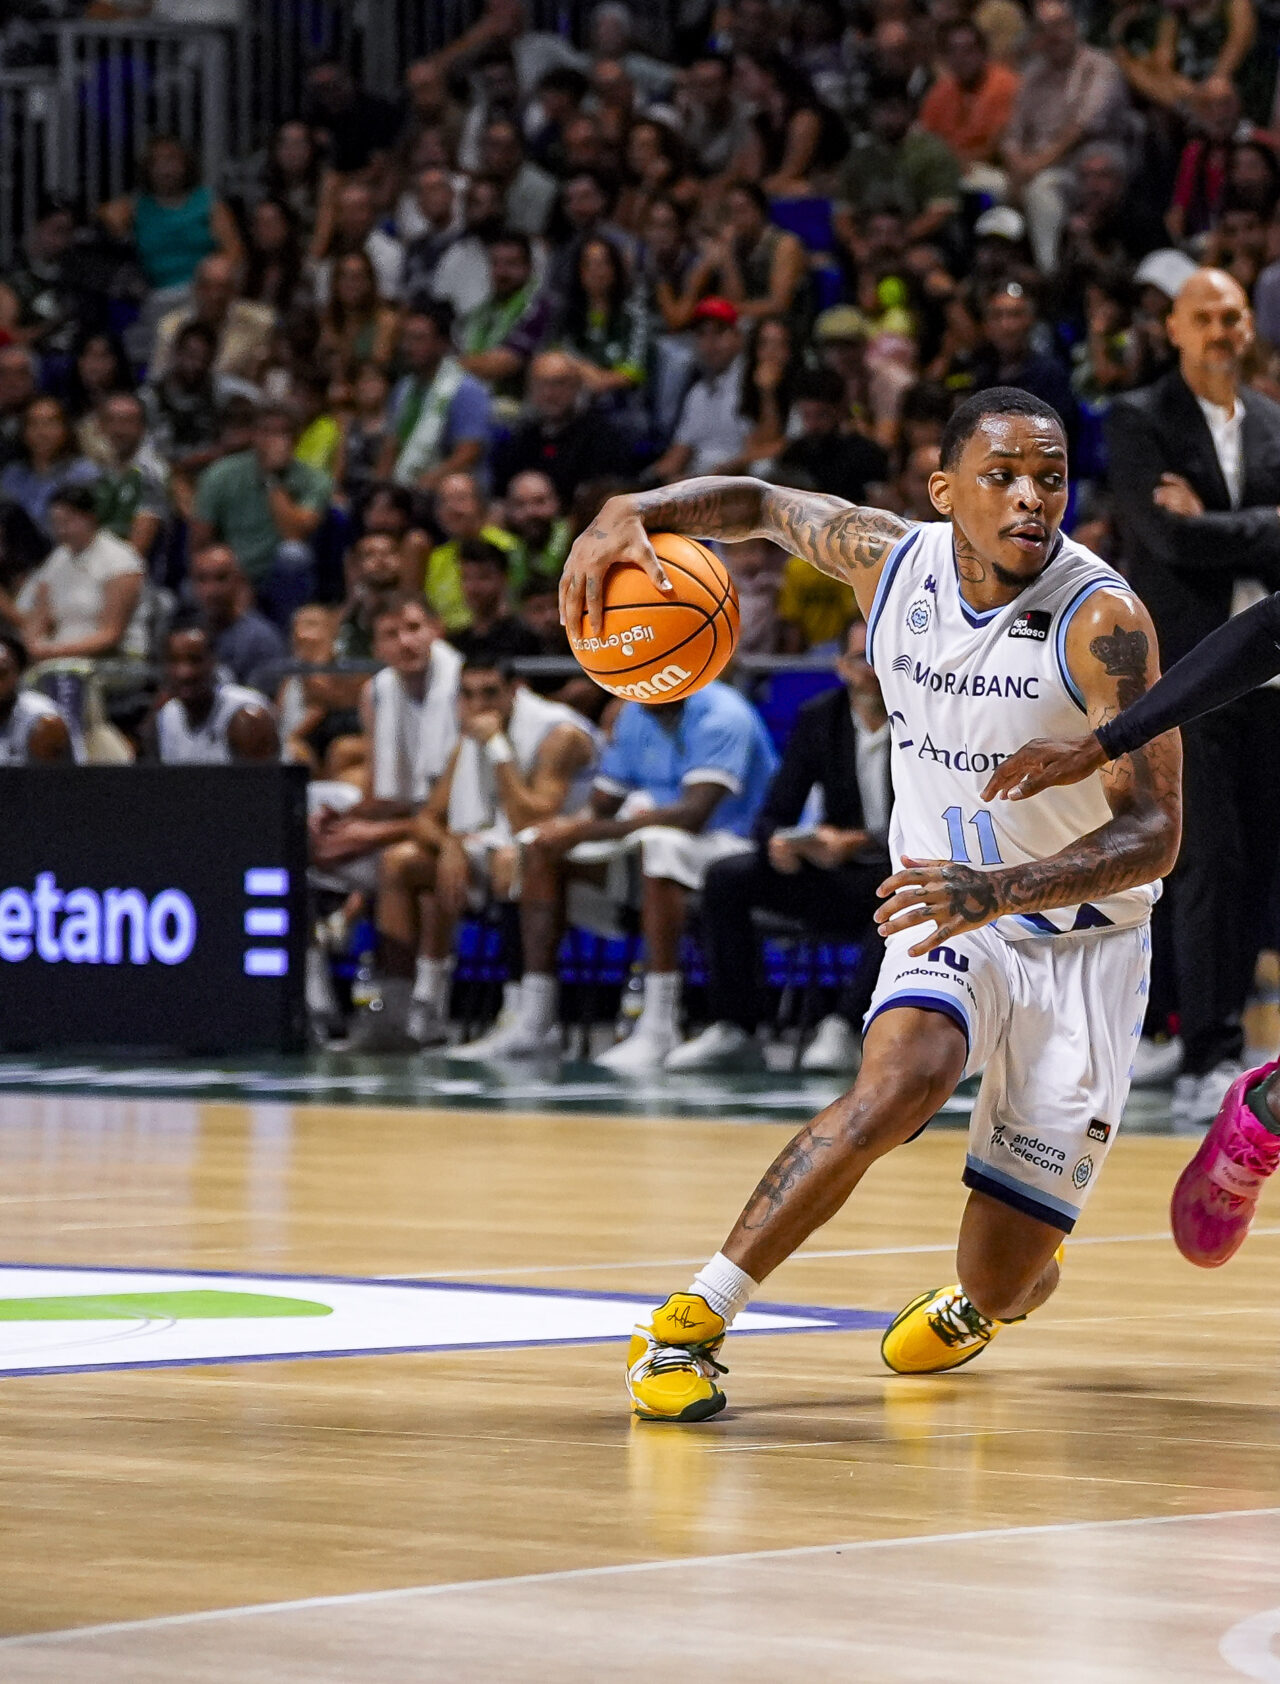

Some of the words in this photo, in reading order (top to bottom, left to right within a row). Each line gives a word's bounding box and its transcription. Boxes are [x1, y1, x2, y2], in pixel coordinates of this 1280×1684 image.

[620, 625, 655, 642] liga
[1010, 627, 1046, 639] endesa
[941, 806, 1004, 865] 11
[0, 869, 198, 966] etano
[894, 967, 950, 985] Andorra
[953, 974, 965, 986] la
[1088, 1126, 1106, 1141] acb
[1008, 1141, 1064, 1176] telecom
[1012, 1134, 1067, 1161] andorra
